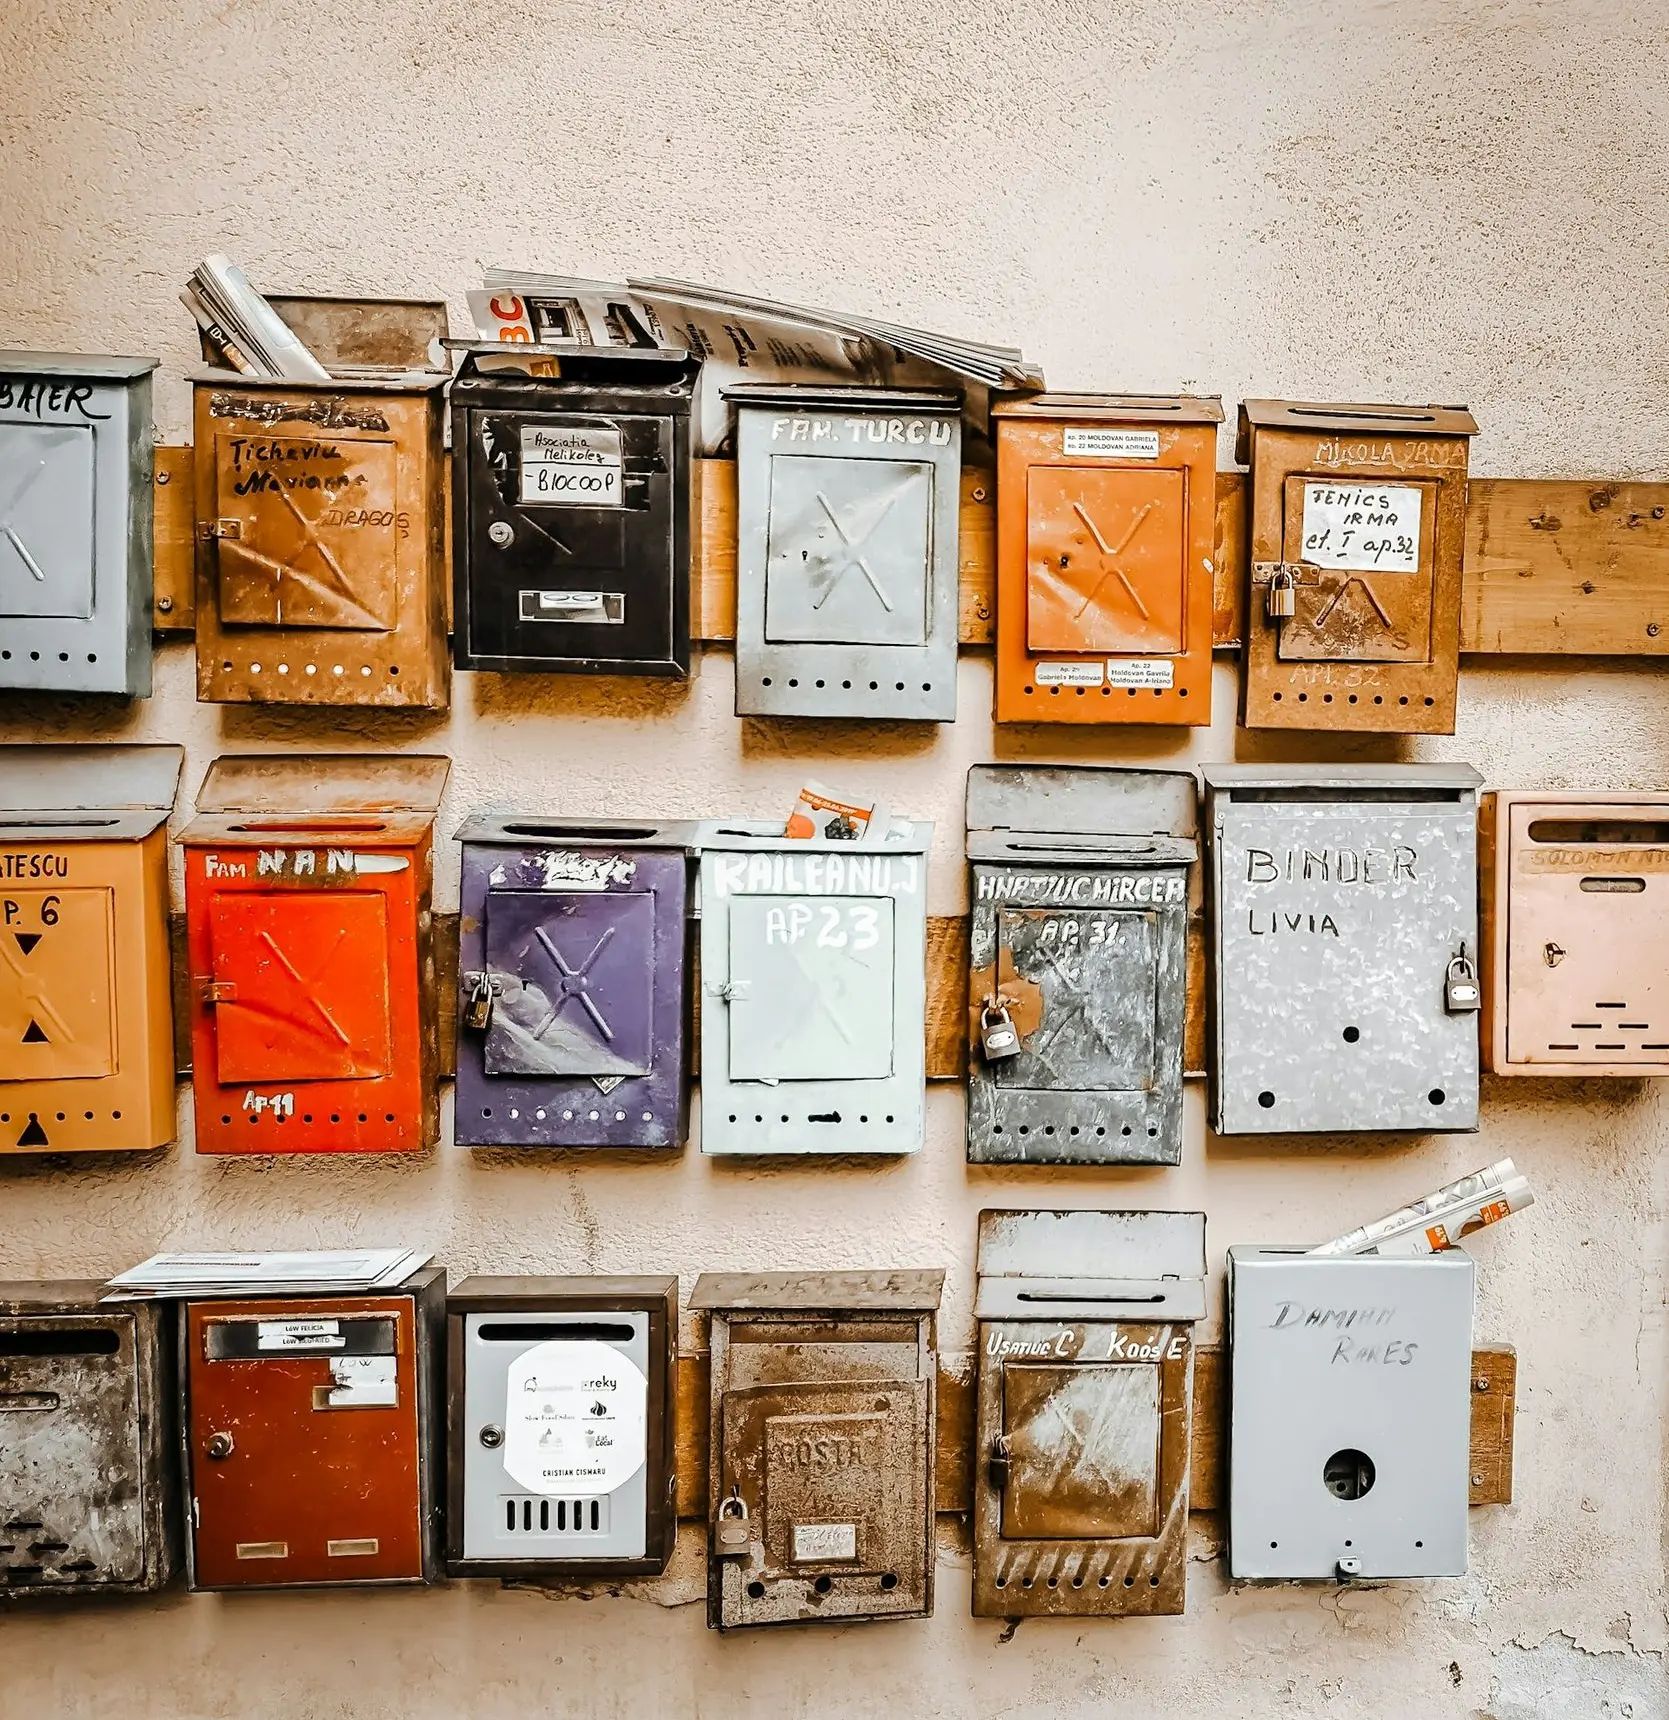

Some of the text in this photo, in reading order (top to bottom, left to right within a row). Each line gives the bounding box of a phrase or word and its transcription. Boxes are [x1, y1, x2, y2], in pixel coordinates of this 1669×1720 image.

[771, 418, 952, 447] FAM. TURCU
[1087, 434, 1124, 442] MOLDOVAN
[1125, 435, 1157, 443] GABRIELA
[1087, 443, 1124, 451] MOLDOVAN
[537, 468, 615, 492] BIOCOOP
[1343, 512, 1399, 527] IRMA
[1305, 528, 1331, 551] et.
[1038, 673, 1067, 681] Gabriela
[1111, 669, 1170, 678] Moldovan Gavrila
[1246, 845, 1419, 885] BINDER
[40, 895, 61, 926] 6
[816, 904, 881, 951] 23
[1248, 908, 1341, 938] LIVIA
[542, 1467, 607, 1477] CRISTIAN CISMARU
